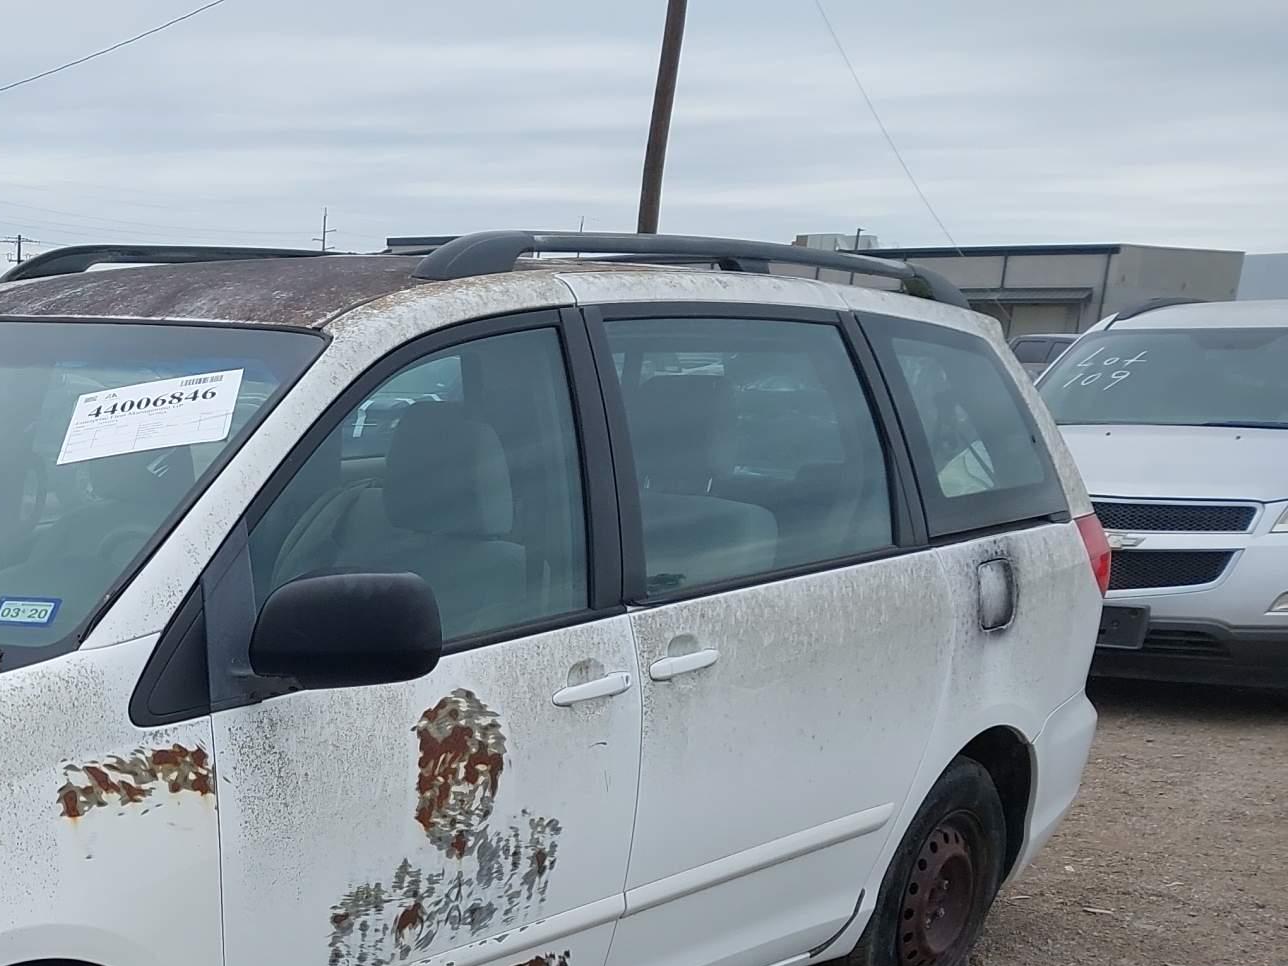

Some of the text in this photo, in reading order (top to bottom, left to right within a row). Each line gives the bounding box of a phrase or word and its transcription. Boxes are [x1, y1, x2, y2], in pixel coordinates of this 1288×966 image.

[1076, 346, 1149, 368] Lot
[1062, 370, 1132, 392] 109
[87, 385, 218, 419] 44006846
[1, 607, 49, 619] 03 20
